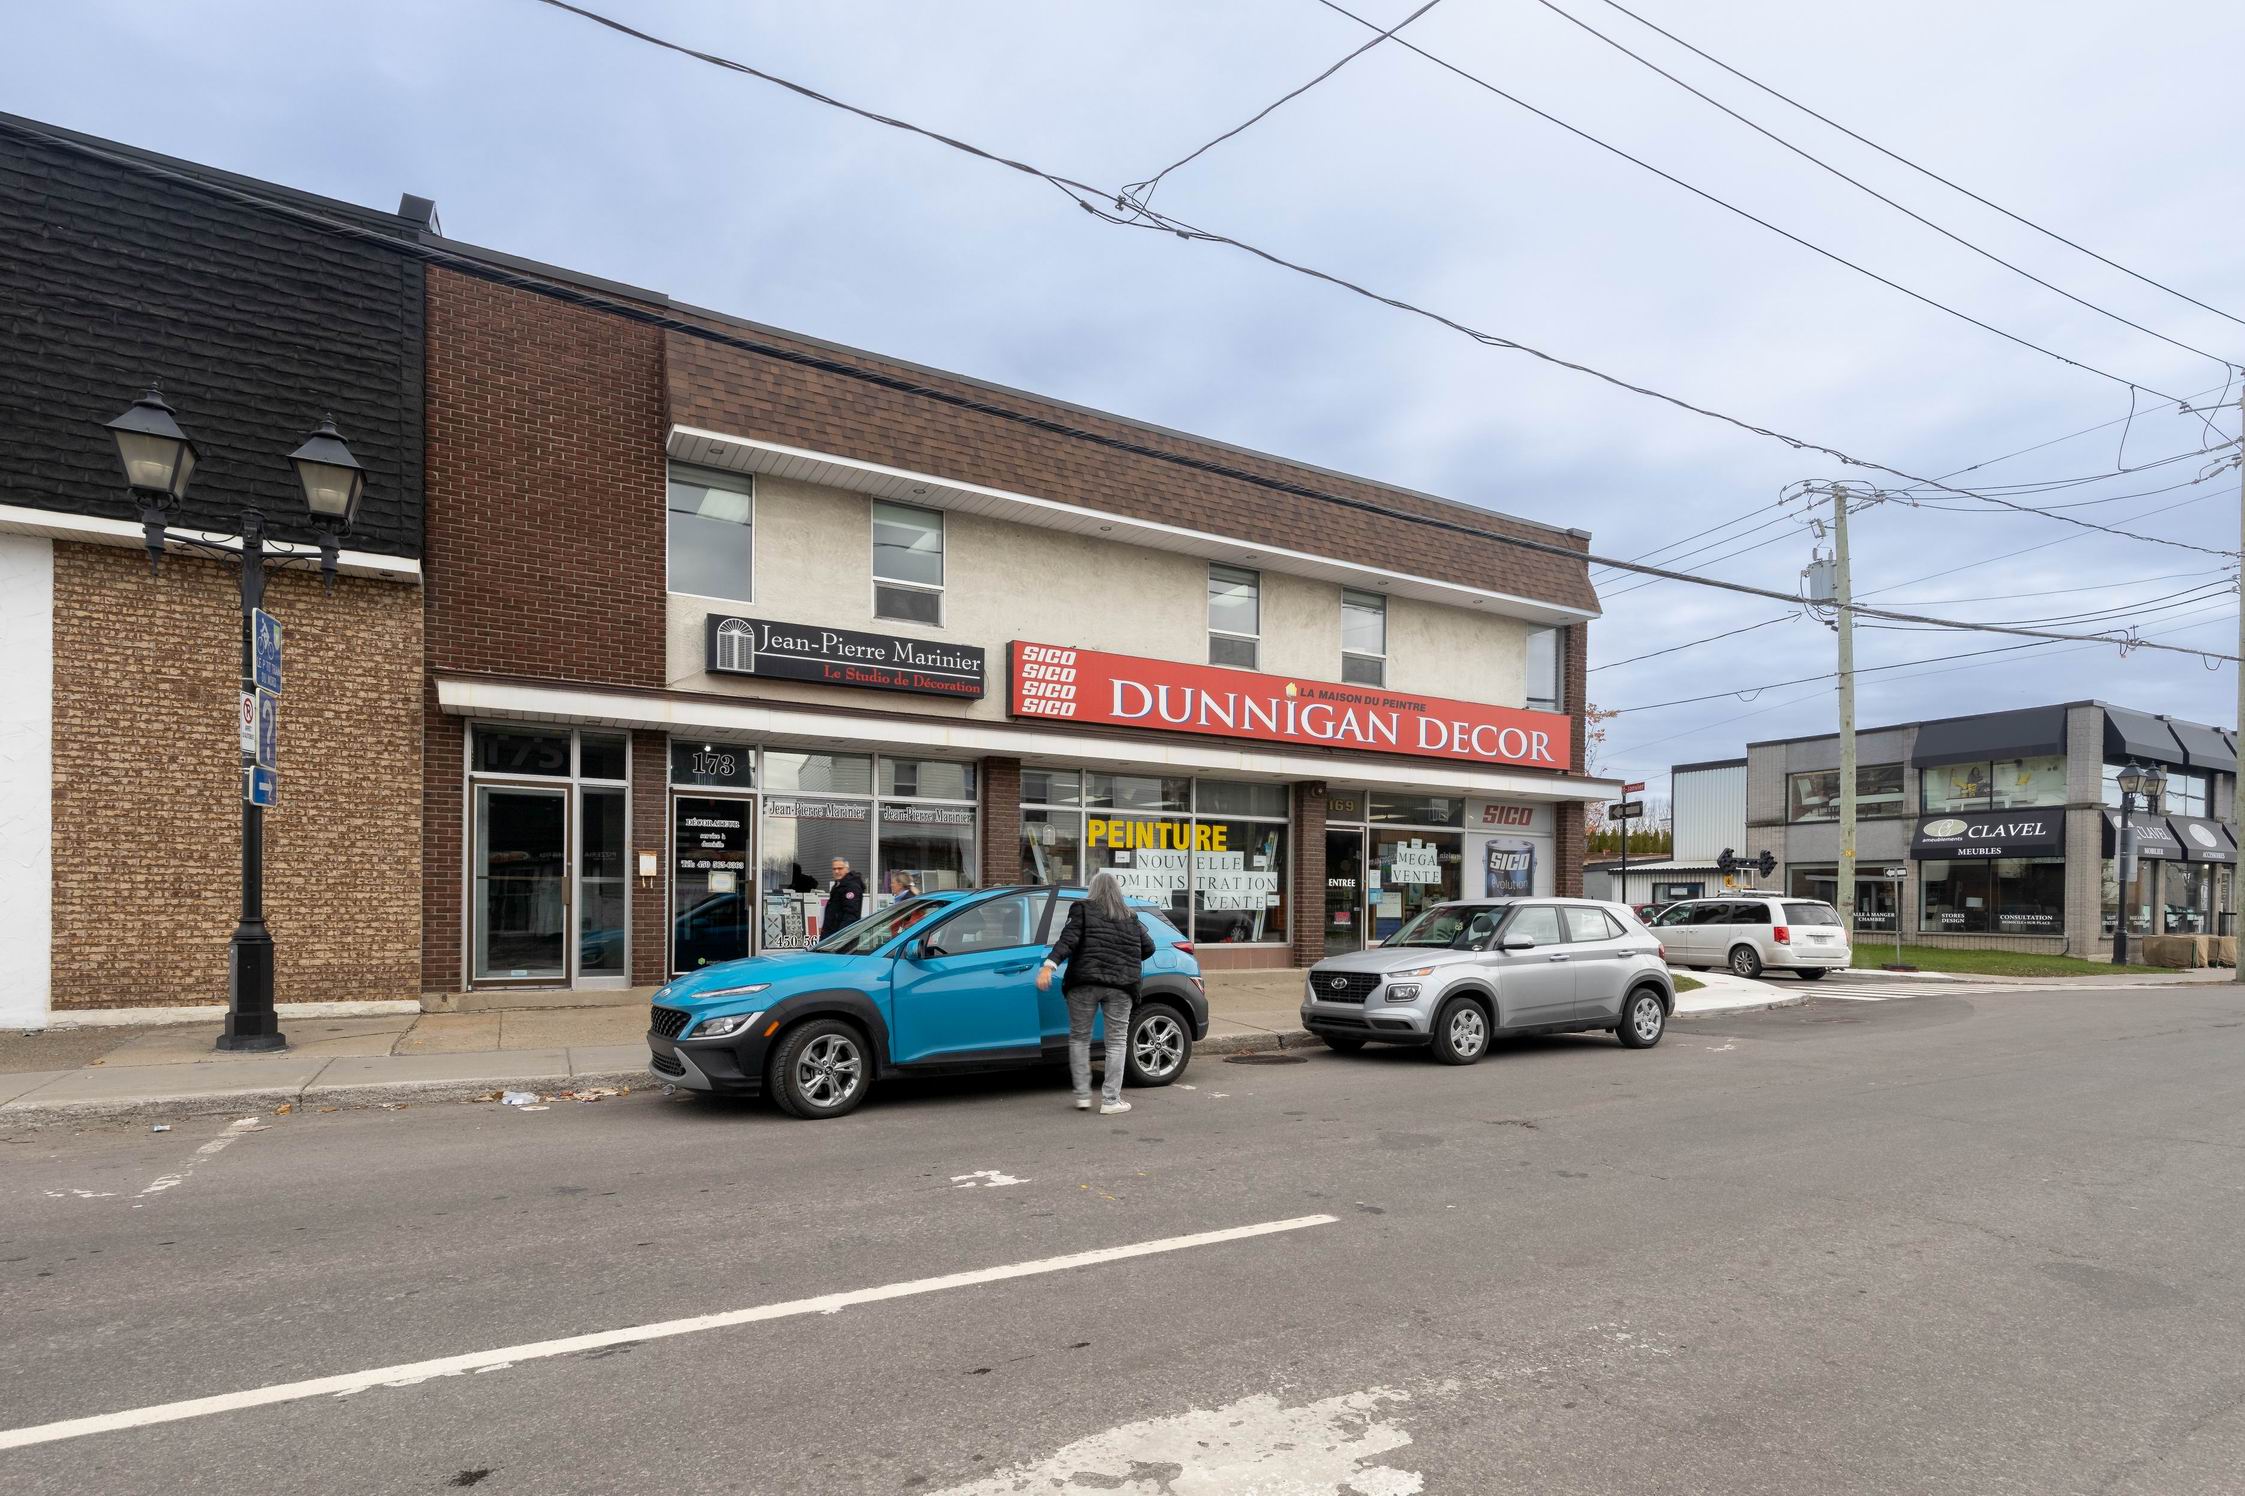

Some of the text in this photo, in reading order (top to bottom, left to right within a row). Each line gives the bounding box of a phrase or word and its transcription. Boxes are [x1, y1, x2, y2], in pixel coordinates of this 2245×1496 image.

[759, 624, 981, 671] Jean-Pierre Marinier
[1022, 646, 1077, 666] SICO
[823, 664, 981, 694] Le Studio de Décoration
[1022, 663, 1077, 682] SICO
[1022, 681, 1077, 699] SICO
[1022, 698, 1077, 717] SICO
[1300, 687, 1427, 713] LA MAISON DU PEINTRE
[1108, 678, 1556, 763] DUNNIGAN DECOR
[692, 752, 735, 776] 173
[769, 801, 866, 819] Jean-Pierre Marinier
[884, 806, 971, 824] Jean-Pierre Marinier
[1328, 800, 1354, 812] 169
[1482, 804, 1534, 826] SICO
[1088, 819, 1228, 852] PEINTURE
[1968, 822, 2047, 838] CLAVEL
[1398, 852, 1436, 866] MEGA
[1958, 847, 2002, 856] MEUBLES
[1138, 854, 1242, 870] NOUVELLE
[1490, 852, 1531, 870] SICO
[1116, 874, 1277, 890] DMINISTRATION
[1393, 870, 1440, 882] VENTE
[1206, 896, 1264, 909] VENTE
[776, 934, 820, 948] 450 56
